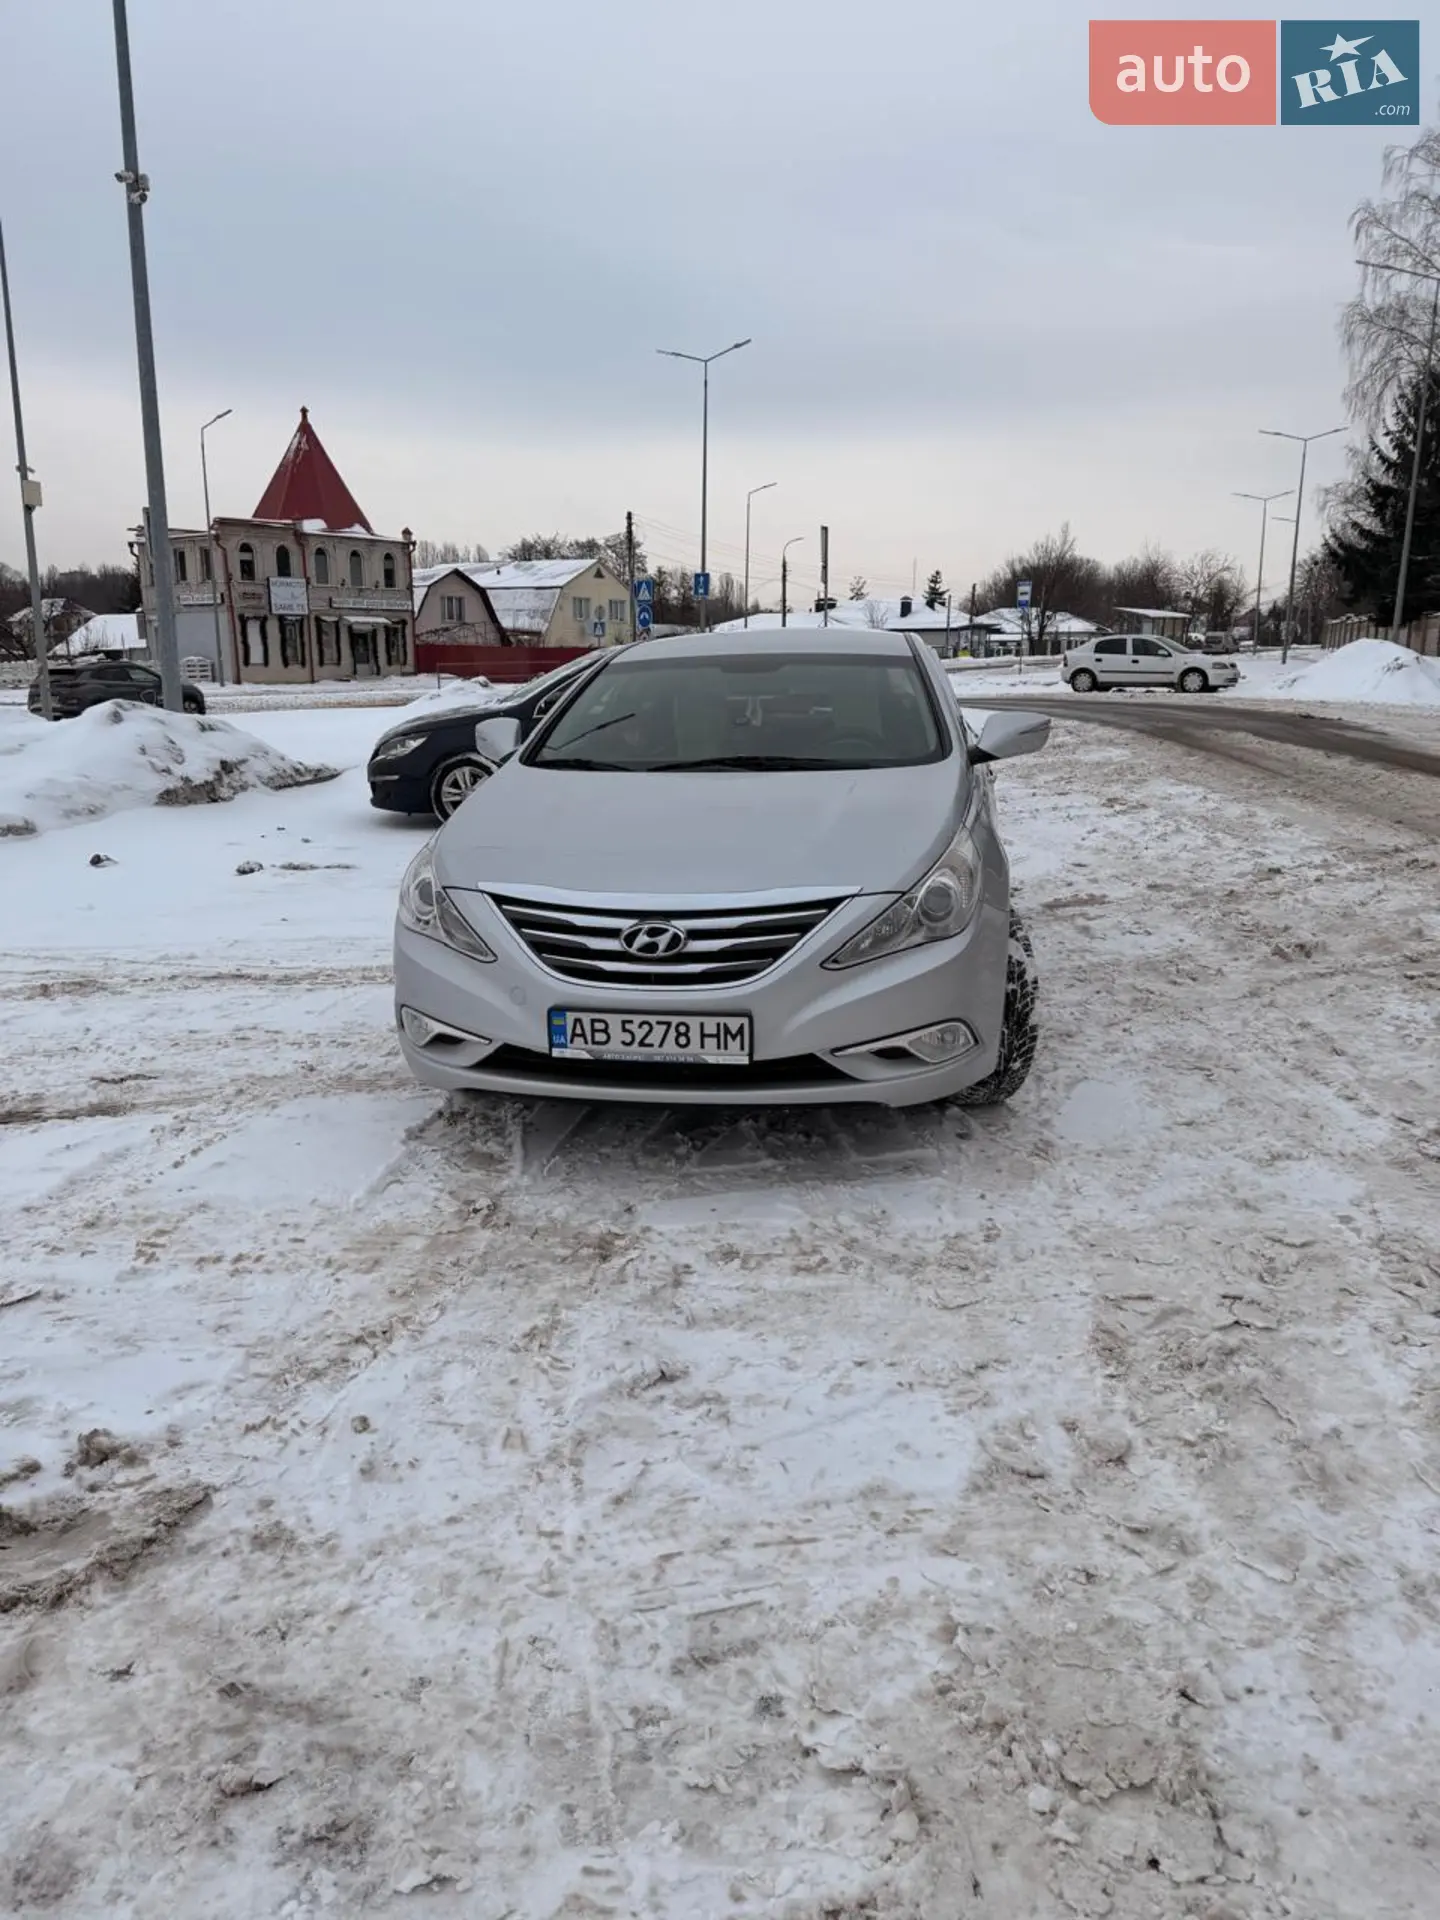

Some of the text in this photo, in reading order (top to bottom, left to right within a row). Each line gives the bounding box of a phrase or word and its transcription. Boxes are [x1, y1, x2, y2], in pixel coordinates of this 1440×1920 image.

[553, 1034, 567, 1044] UA
[569, 1017, 745, 1052] AB 5278 HM
